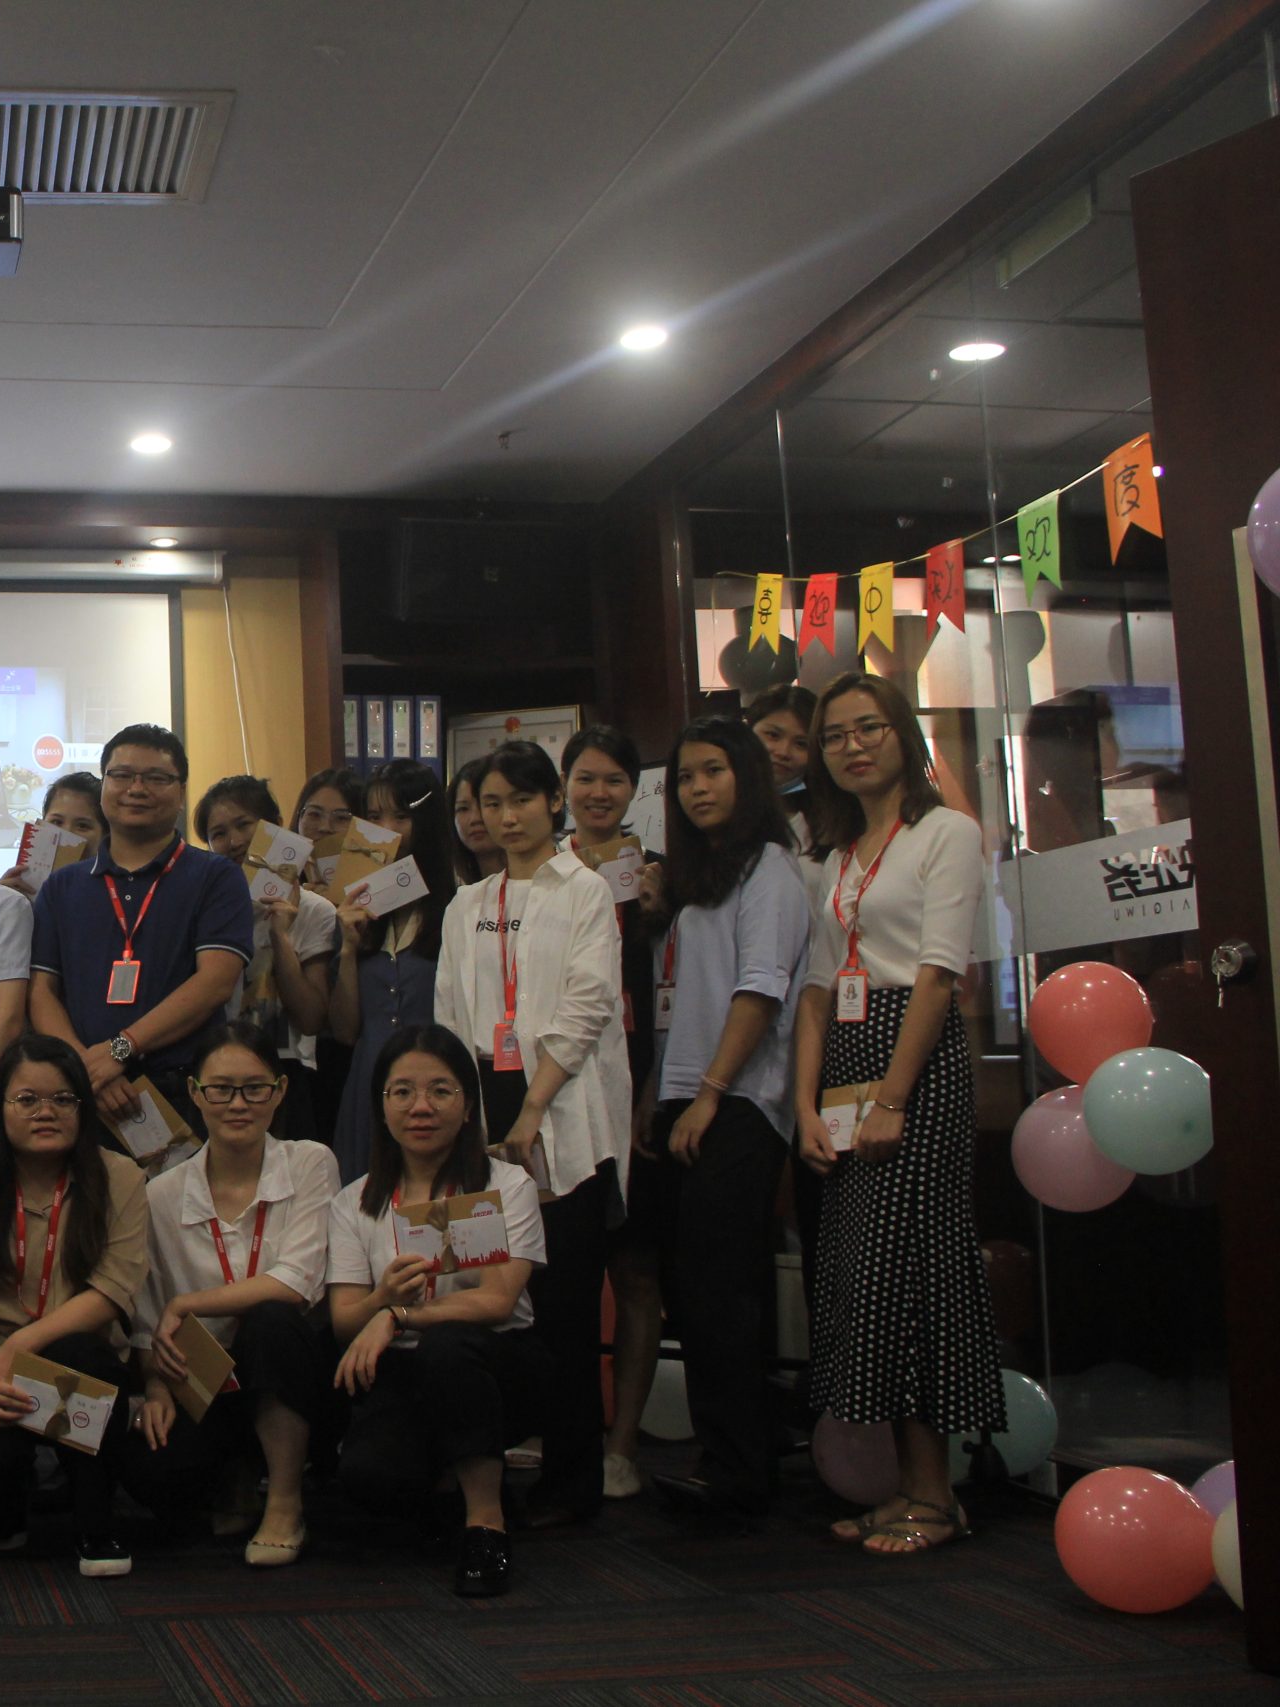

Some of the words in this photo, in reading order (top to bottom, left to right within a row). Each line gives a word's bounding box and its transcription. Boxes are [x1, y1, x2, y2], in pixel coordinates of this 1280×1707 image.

[864, 581, 883, 621] 中
[1025, 515, 1051, 562] 欢
[1114, 464, 1141, 517] 度
